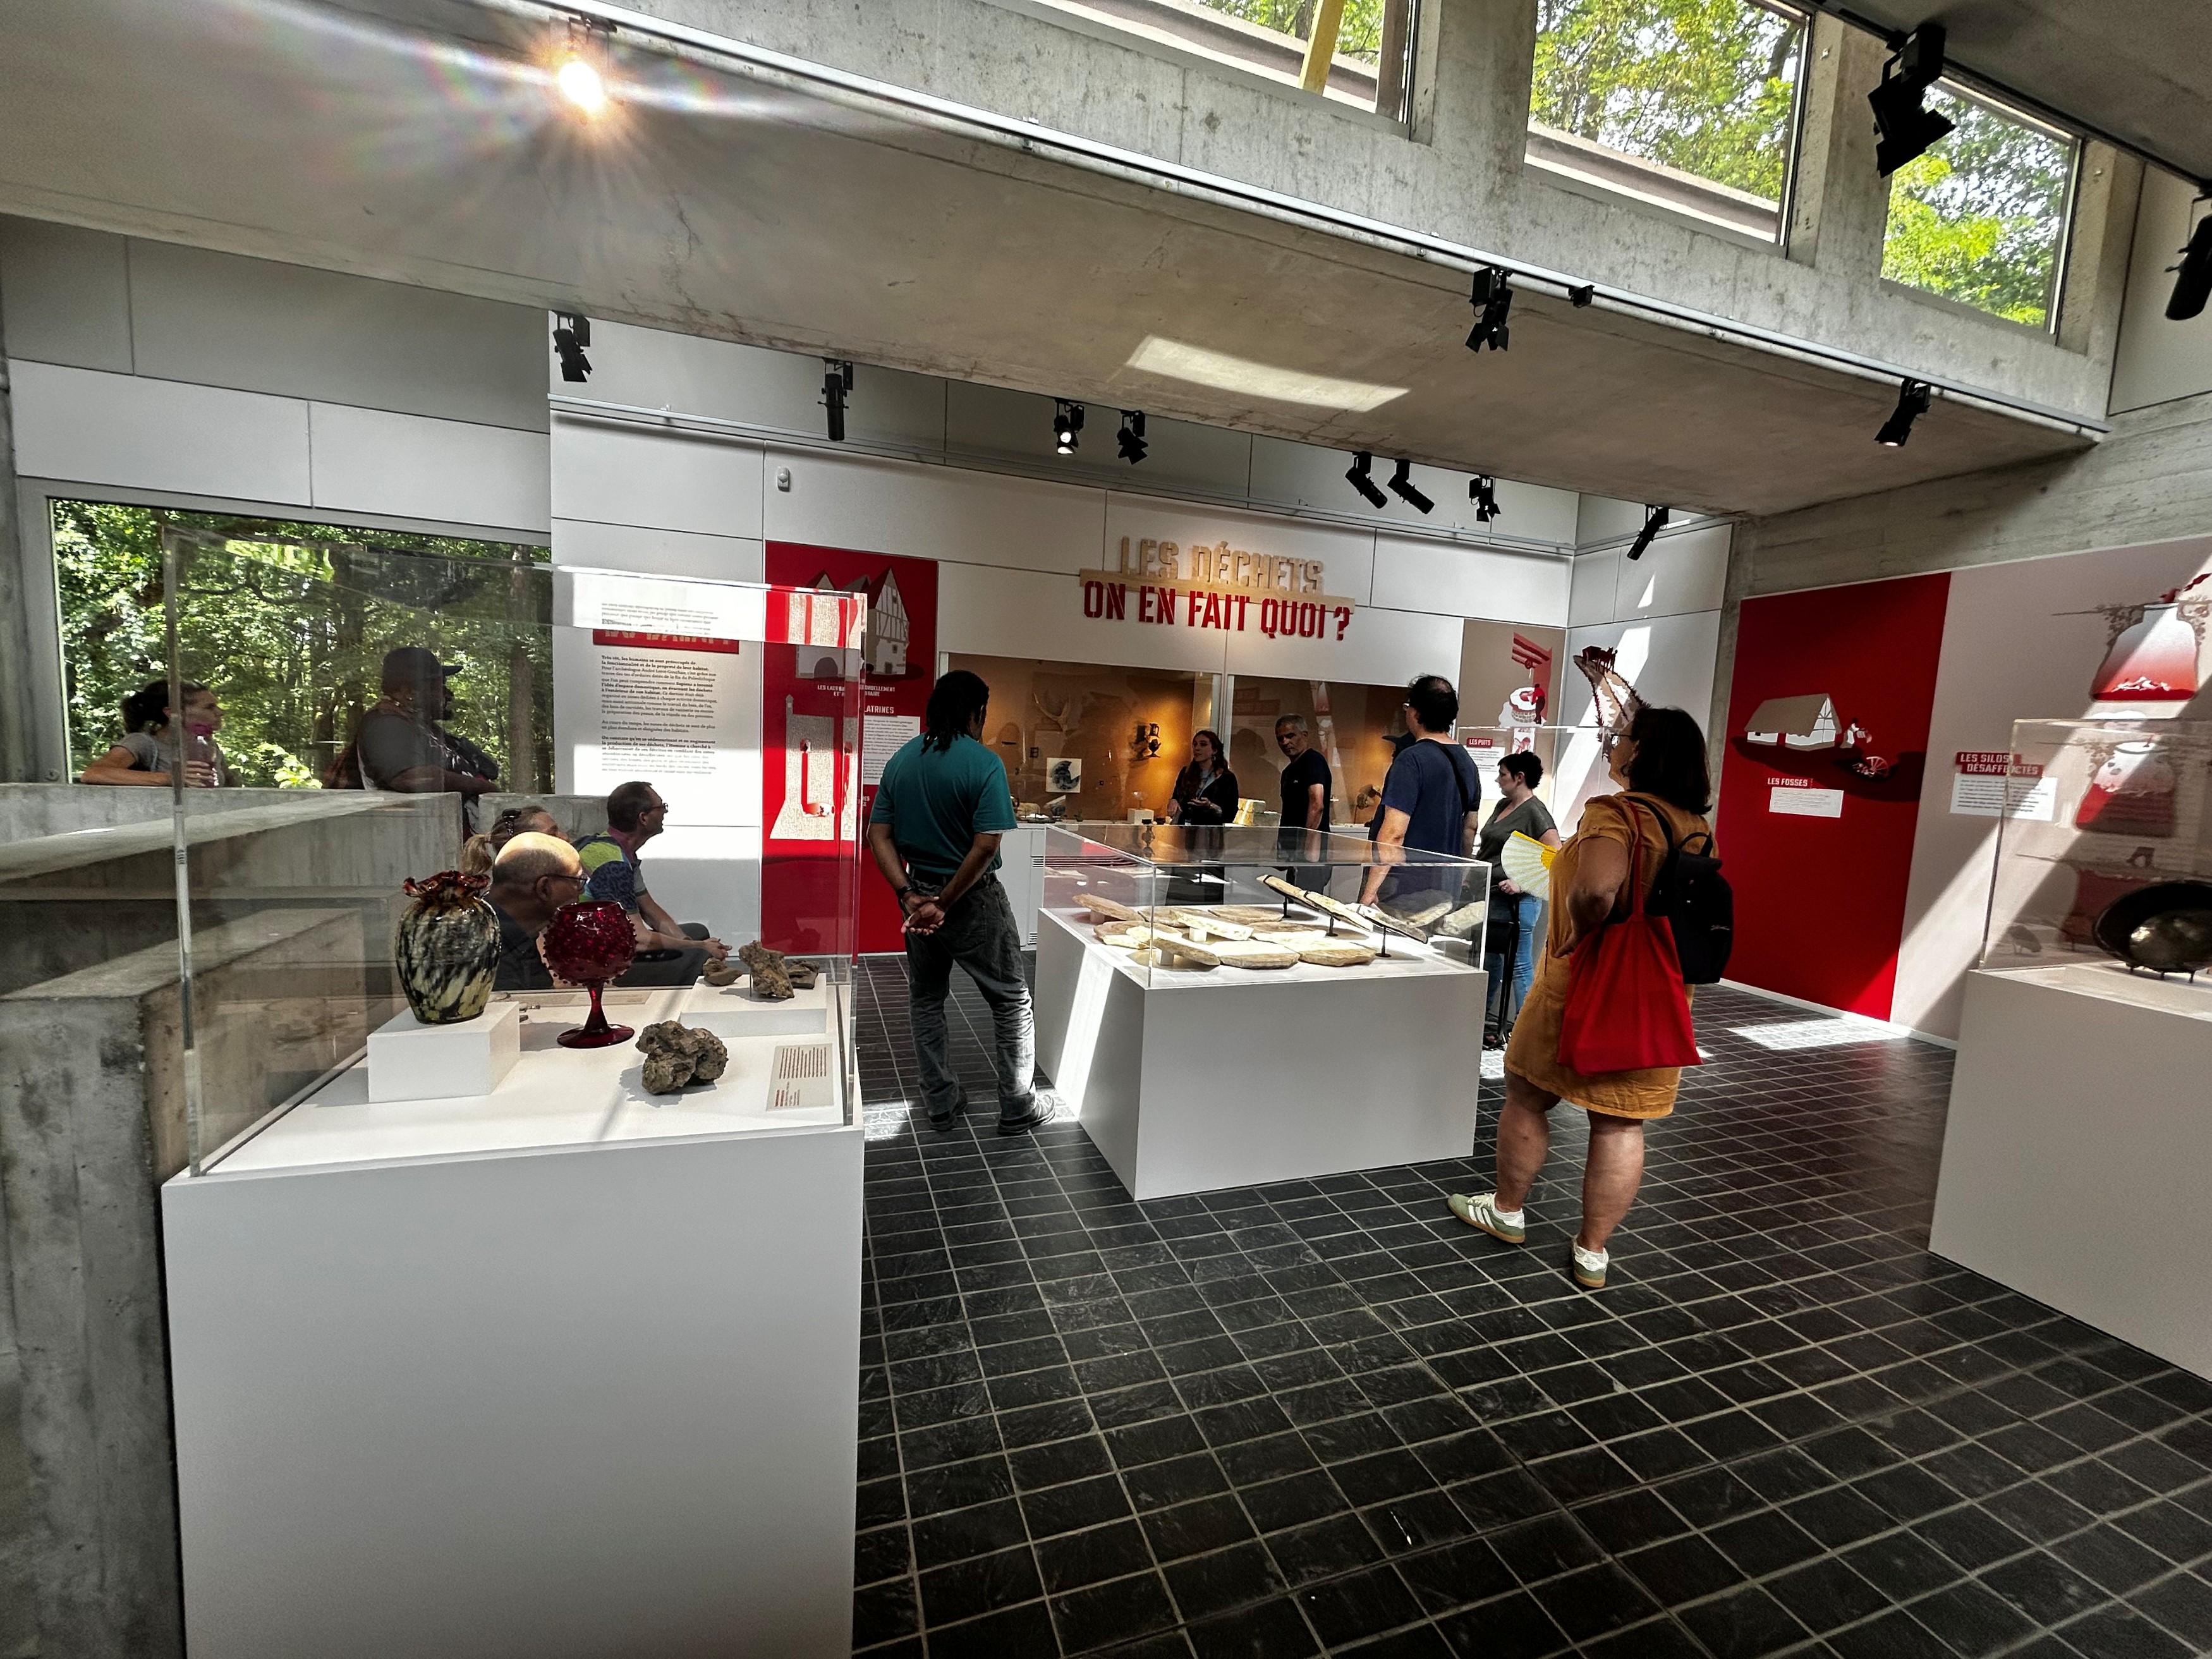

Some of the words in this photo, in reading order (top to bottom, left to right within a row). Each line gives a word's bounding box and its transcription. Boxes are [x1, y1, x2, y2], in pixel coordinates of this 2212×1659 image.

[1121, 536, 1179, 580] LES
[1191, 541, 1324, 593] DÉCHETS
[1084, 580, 1126, 620] ON
[1139, 585, 1176, 624] EN
[1188, 590, 1250, 631] FAIT
[1260, 598, 1325, 639] QUOI
[1334, 606, 1351, 641] ?
[1960, 753, 1978, 762] LES
[1980, 753, 2009, 763] SILOS
[1781, 778, 1808, 787] FOSSES
